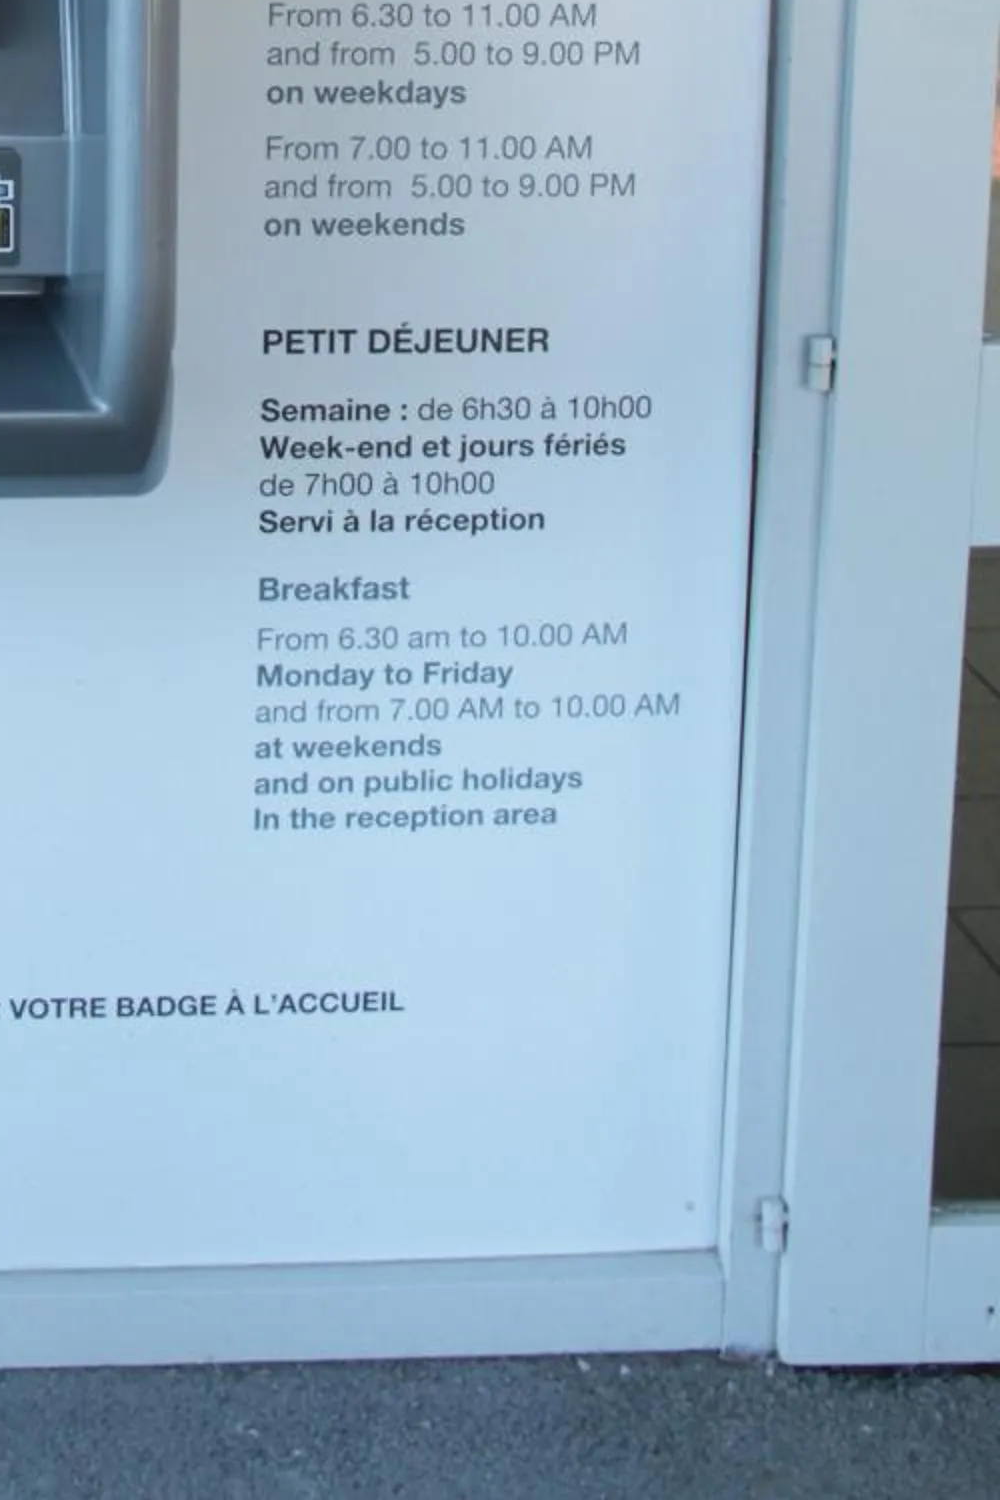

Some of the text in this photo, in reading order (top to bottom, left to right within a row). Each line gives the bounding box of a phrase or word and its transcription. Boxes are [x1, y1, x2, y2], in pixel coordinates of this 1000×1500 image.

[268, 1, 597, 29] From 6.30 to 11.00 AM
[266, 40, 641, 67] and from 5.00 to 9.00 PM
[266, 79, 467, 110] on weekdays
[265, 134, 593, 162] From 7.00 to 11.00 AM
[263, 172, 636, 200] and from 5.00 to 9.00 PM
[263, 211, 465, 238] on weekends
[263, 322, 549, 355] PETIT DÉJEUNER
[260, 397, 391, 423] Semaine
[417, 397, 454, 421] de
[462, 396, 531, 421] 6h30
[540, 396, 557, 420] à
[568, 395, 652, 420] 10h00
[259, 432, 626, 464] Week-end et jours fériés
[259, 470, 495, 498] de 7h00 à 10h00
[258, 507, 545, 537] Servi à la réception
[258, 575, 410, 602] Breakfast
[257, 621, 628, 652] From 6.30 am to 10.00 AM
[256, 660, 514, 692] Monday to Friday
[254, 691, 681, 724] and from 7.00 AM to 10.00 AM
[254, 733, 442, 760] at weekends
[253, 766, 584, 799] and on public holidays
[253, 803, 558, 833] In the reception area
[9, 996, 107, 1021] VOTRE
[115, 994, 217, 1019] BADGE
[224, 988, 246, 1016] À
